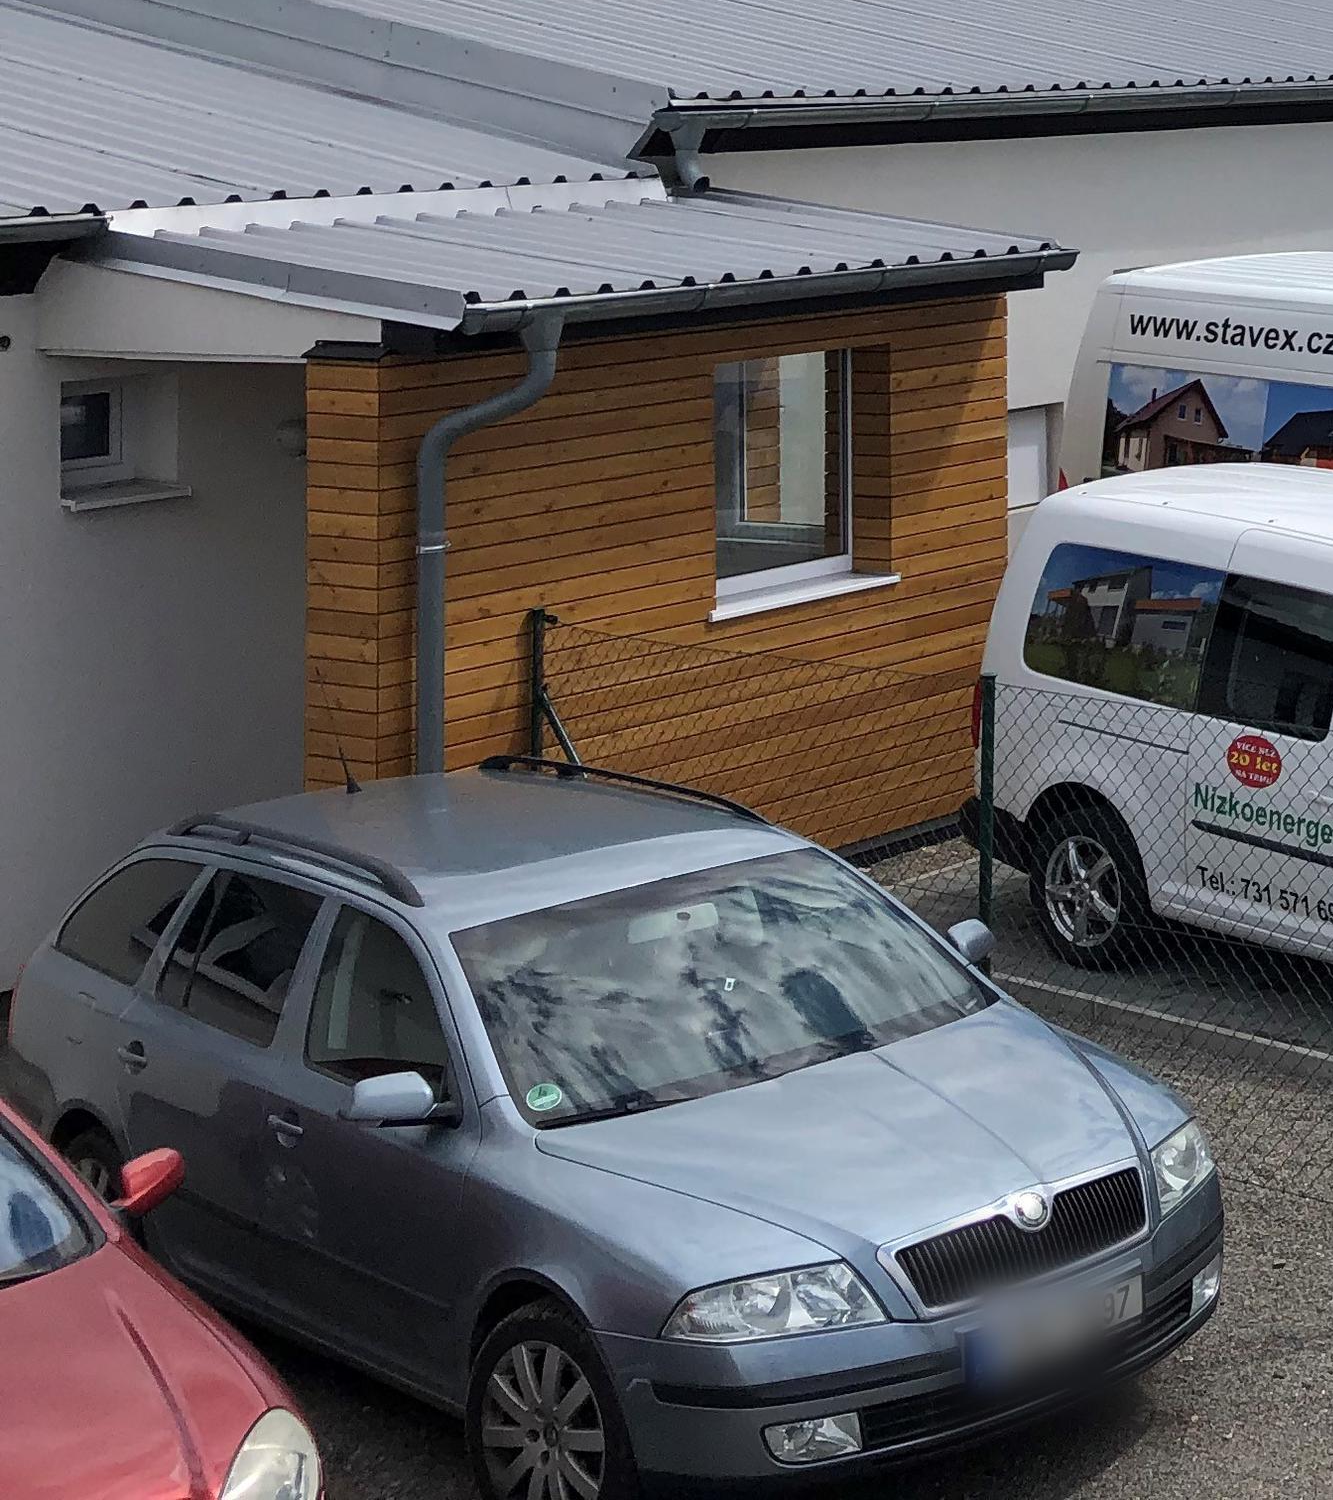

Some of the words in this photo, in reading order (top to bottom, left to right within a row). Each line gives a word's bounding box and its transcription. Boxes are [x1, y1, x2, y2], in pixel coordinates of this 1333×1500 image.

[1230, 750, 1250, 765] 20
[1196, 866, 1236, 897] Tel.:
[1240, 878, 1271, 905] 731
[1280, 888, 1309, 917] 571
